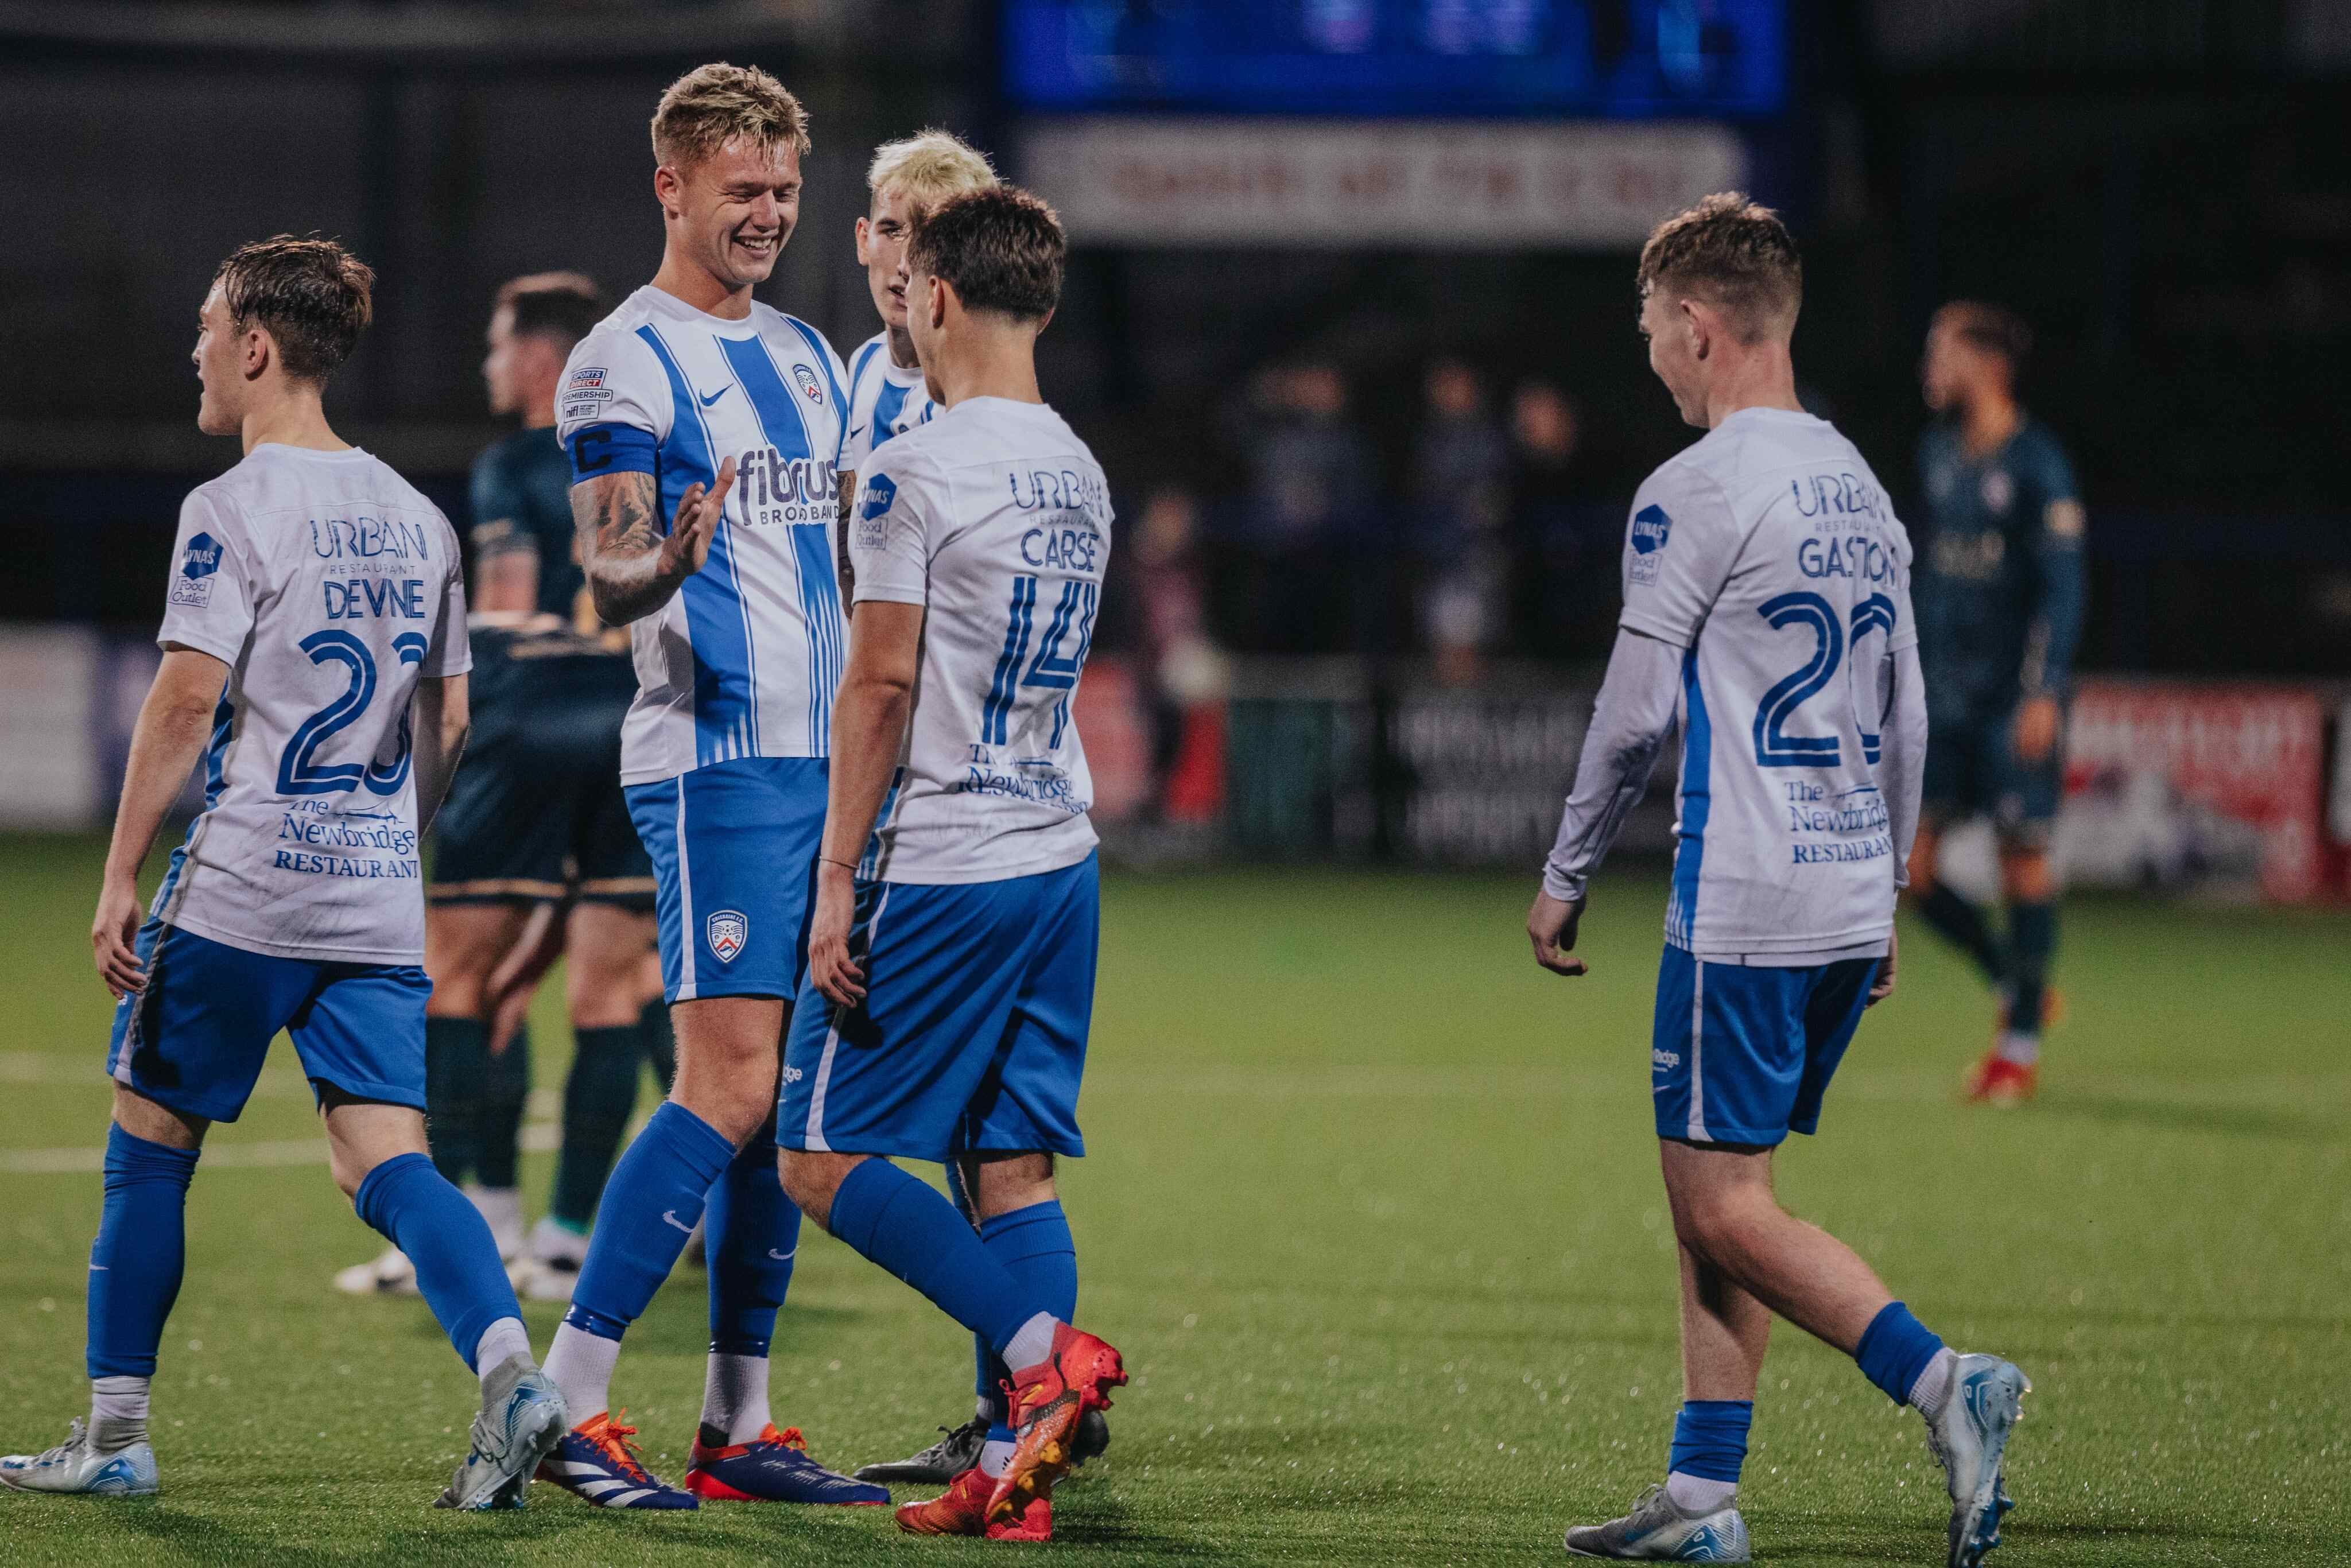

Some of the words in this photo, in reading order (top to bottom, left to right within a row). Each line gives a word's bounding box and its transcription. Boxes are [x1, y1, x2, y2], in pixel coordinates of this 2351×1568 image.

[570, 379, 599, 389] DIRECT
[573, 371, 601, 379] SPORTS
[563, 391, 610, 401] REMIERSHIP
[576, 430, 612, 473] C
[736, 448, 840, 526] fibrus
[310, 517, 428, 561] URBAN
[330, 563, 417, 576] RESTAURANT
[172, 591, 207, 605] Outlet
[179, 580, 207, 592] Food
[981, 576, 1096, 750] 14
[1784, 781, 1824, 801] The
[1788, 798, 1890, 832] Newbridg
[278, 813, 415, 855] Newbridge
[273, 849, 418, 878] RESTAURANT
[1792, 834, 1893, 864] RESTAURAN
